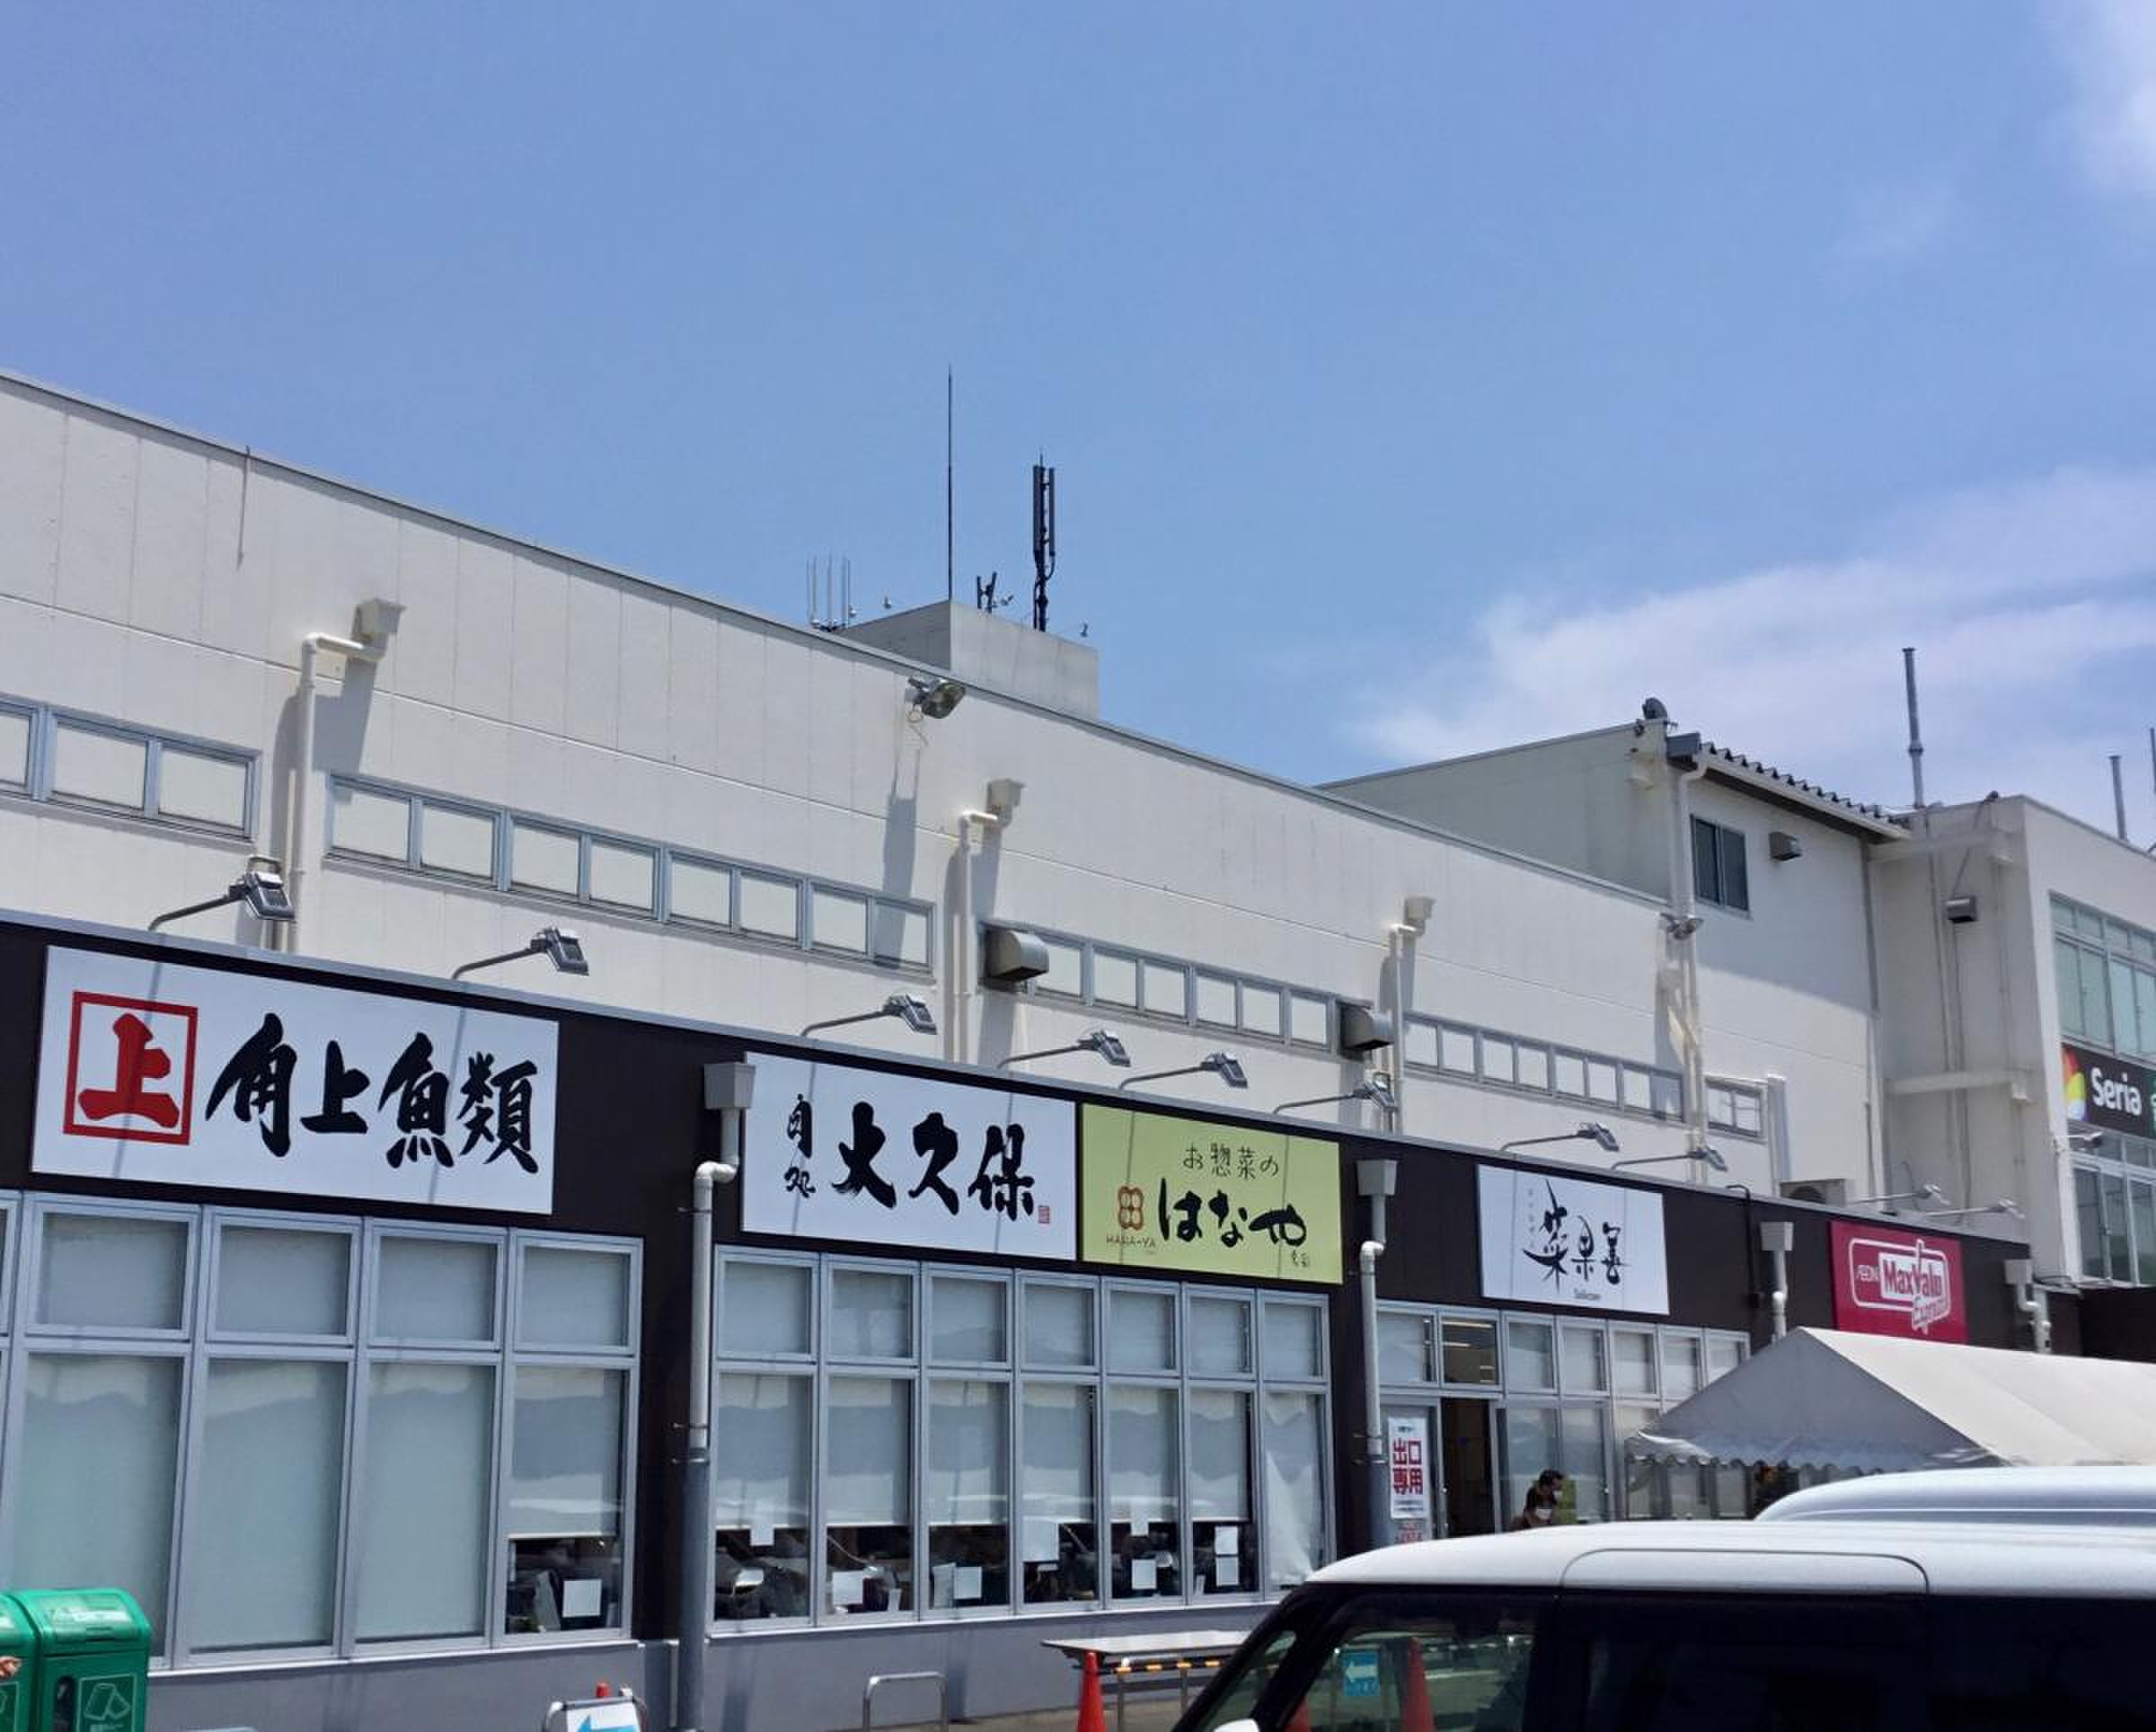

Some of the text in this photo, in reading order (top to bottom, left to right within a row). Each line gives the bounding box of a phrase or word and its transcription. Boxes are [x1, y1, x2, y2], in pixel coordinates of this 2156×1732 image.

[79, 1013, 180, 1127] 上
[205, 1012, 540, 1173] 角上魚類
[2090, 1066, 2142, 1116] Seria
[832, 1101, 1035, 1221] 大久保
[1183, 1142, 1279, 1180] お惣菜の
[1159, 1176, 1307, 1248] はなや
[1392, 1438, 1422, 1465] 出口
